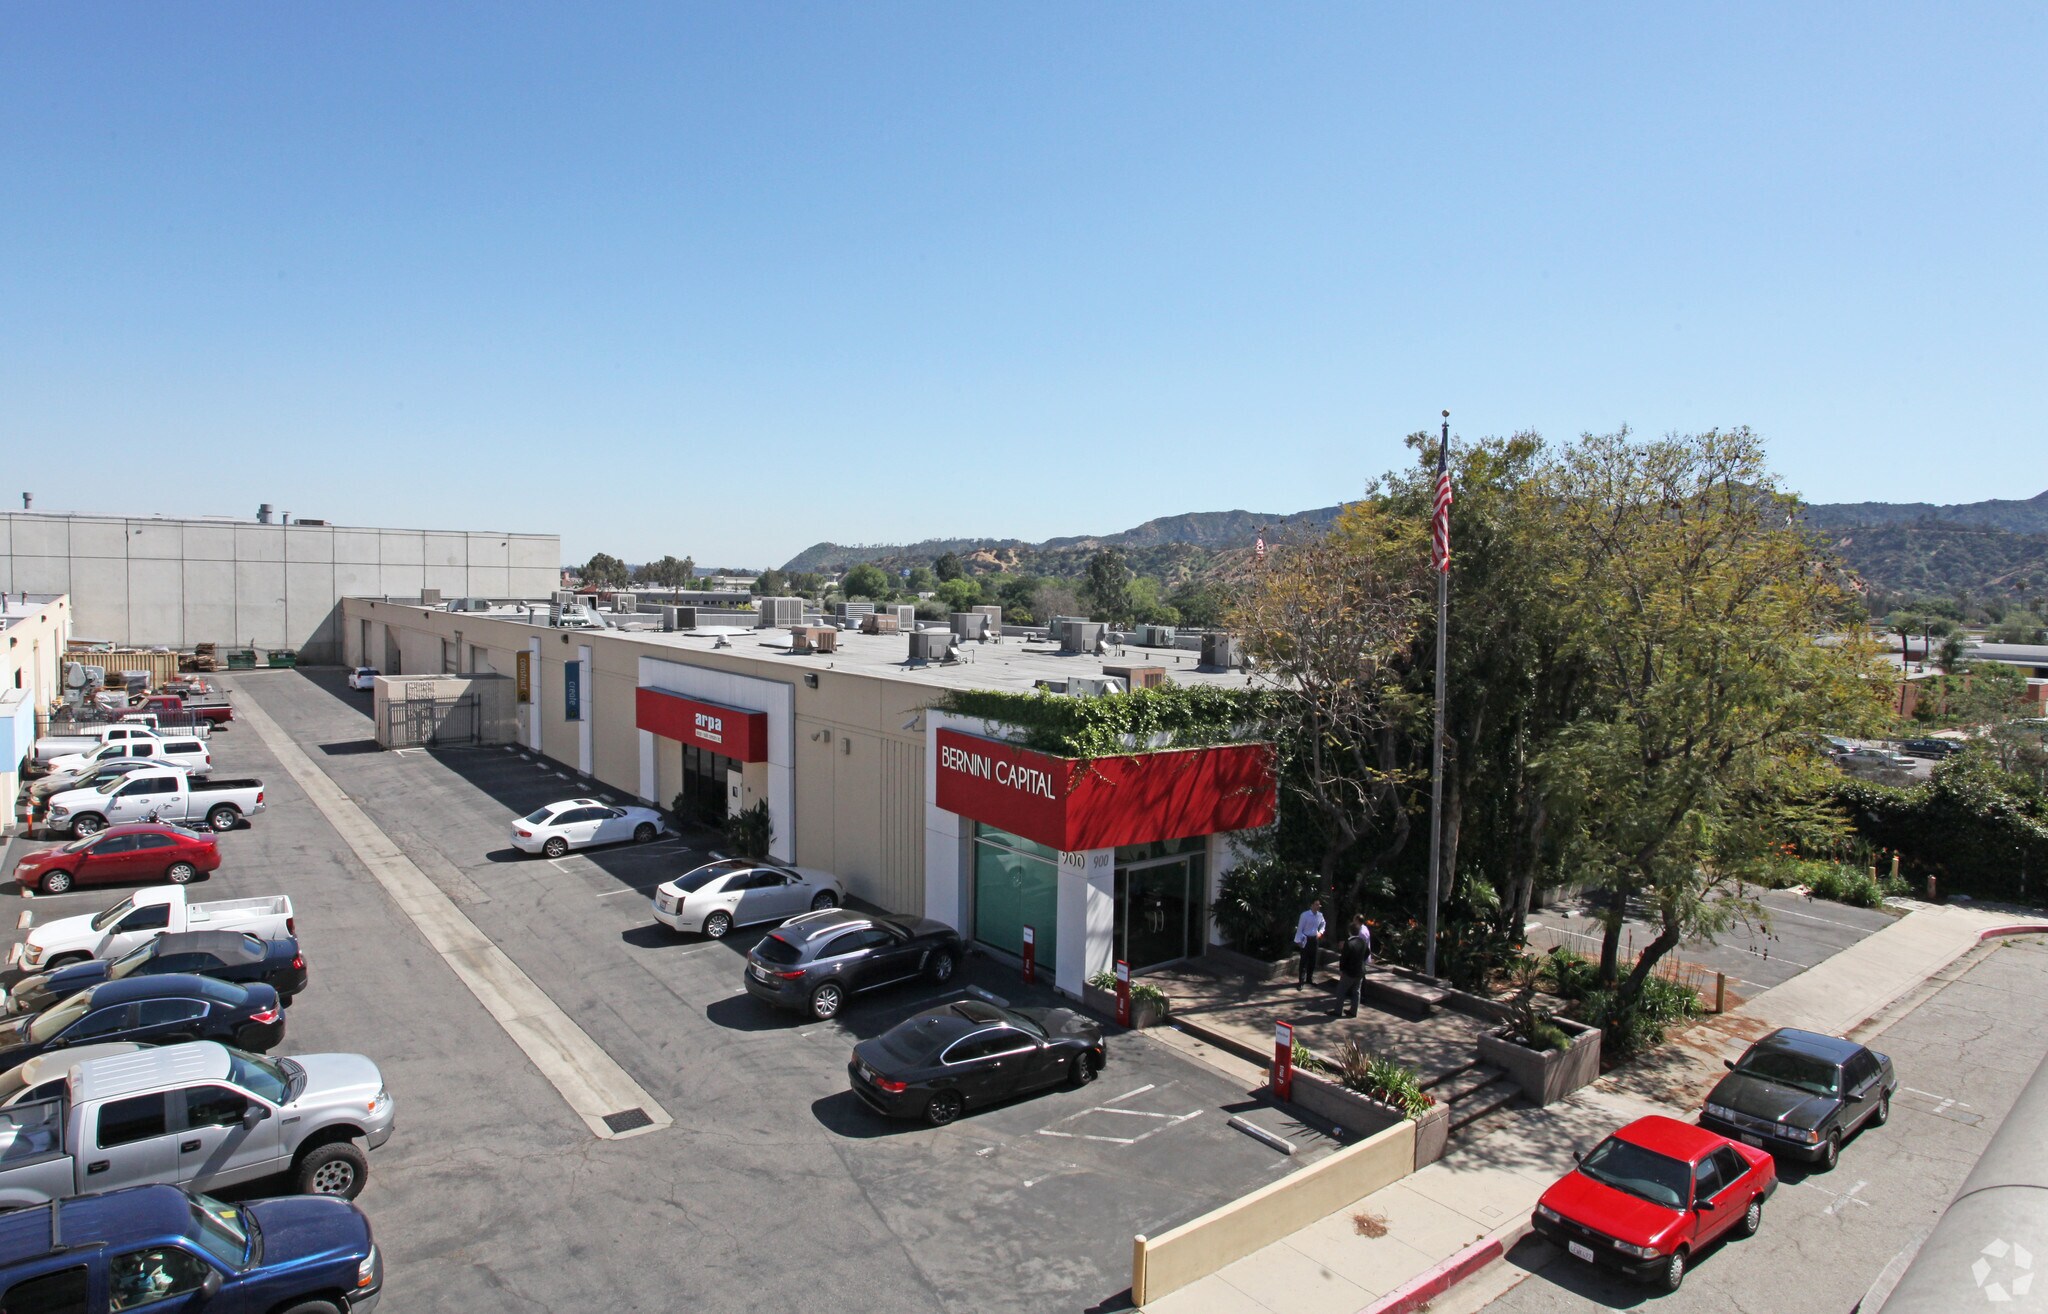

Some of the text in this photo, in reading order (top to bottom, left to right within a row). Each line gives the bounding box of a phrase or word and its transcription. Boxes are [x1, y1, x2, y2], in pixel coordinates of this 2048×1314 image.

[568, 681, 576, 706] create
[695, 712, 722, 731] arpa
[942, 745, 1056, 800] BERNINI CAPITAL
[1060, 851, 1085, 869] 900
[1093, 854, 1109, 869] 900
